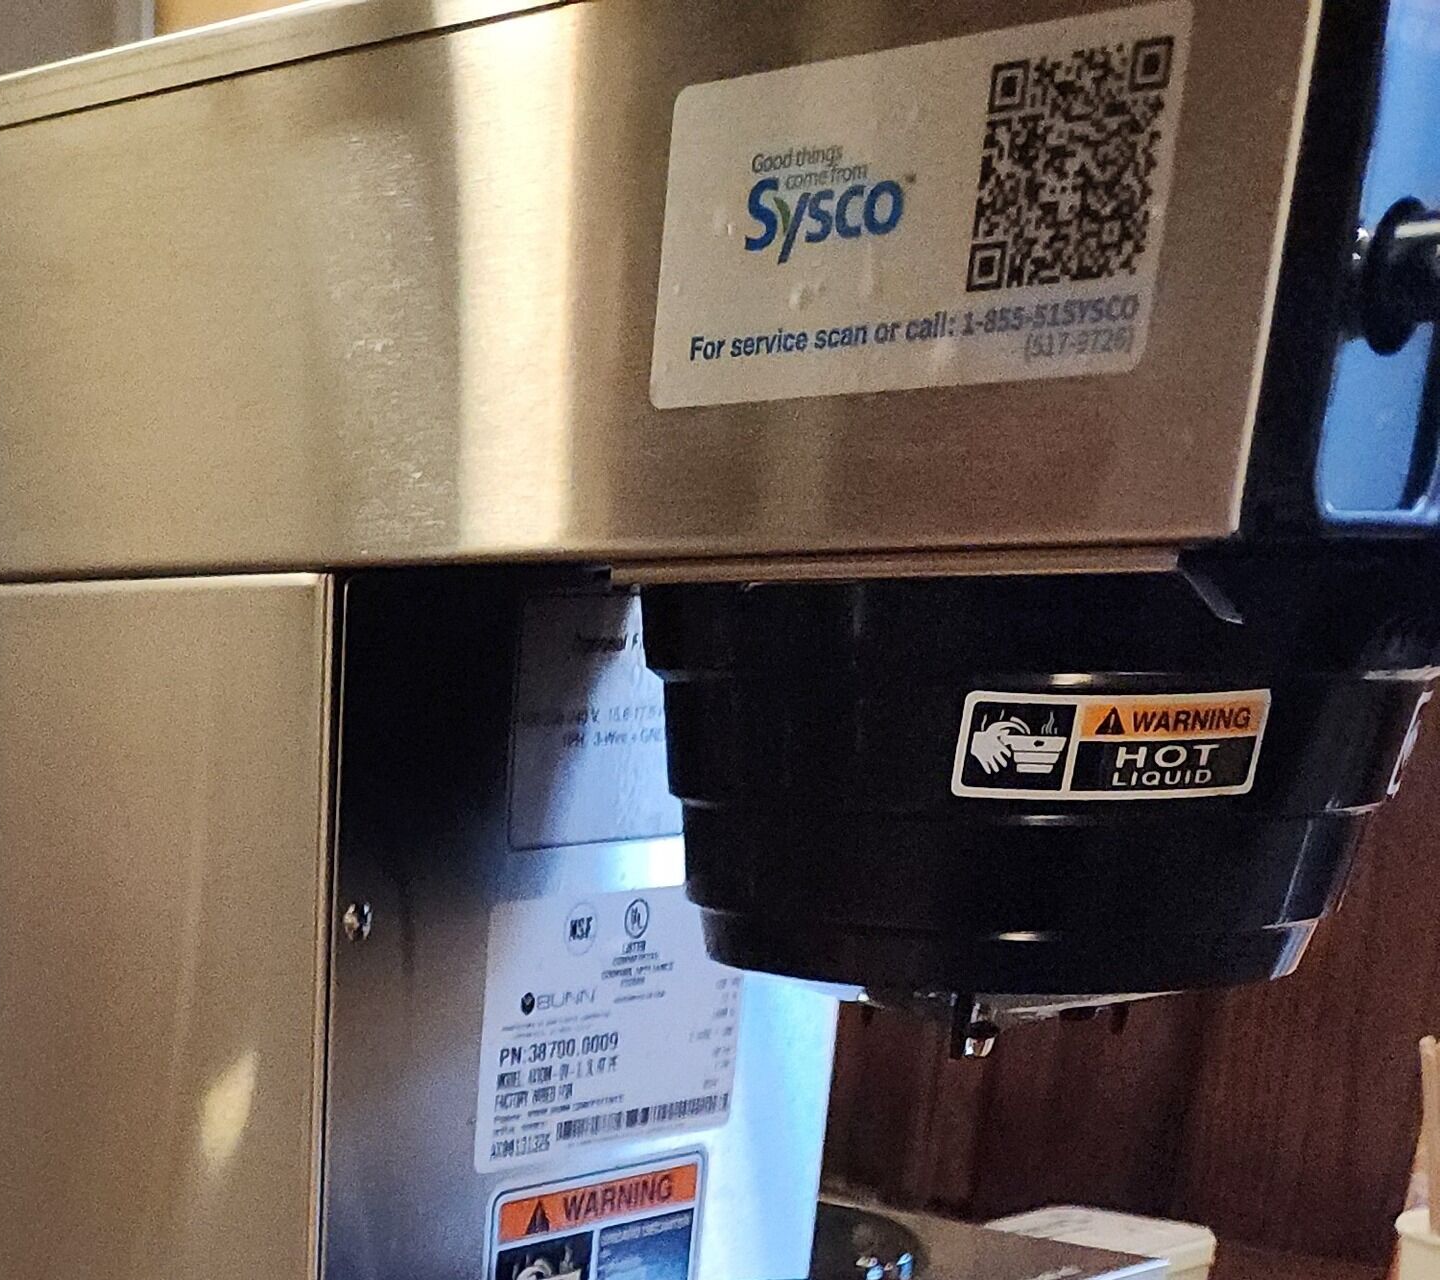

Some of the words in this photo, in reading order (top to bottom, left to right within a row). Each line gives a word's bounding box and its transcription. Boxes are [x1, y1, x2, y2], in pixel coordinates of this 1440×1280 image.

[751, 149, 793, 174] Good
[796, 145, 844, 169] things
[785, 170, 829, 190] come
[831, 163, 868, 184] from
[689, 335, 726, 361] For
[730, 328, 808, 358] service
[814, 324, 868, 350] scan
[873, 321, 901, 344] or
[906, 310, 956, 341] call:
[1132, 706, 1251, 733] WARNING
[1115, 744, 1220, 769] HOT
[1111, 769, 1213, 787] LIQUID
[569, 916, 593, 941] NSF
[563, 1174, 674, 1222] WARNING
